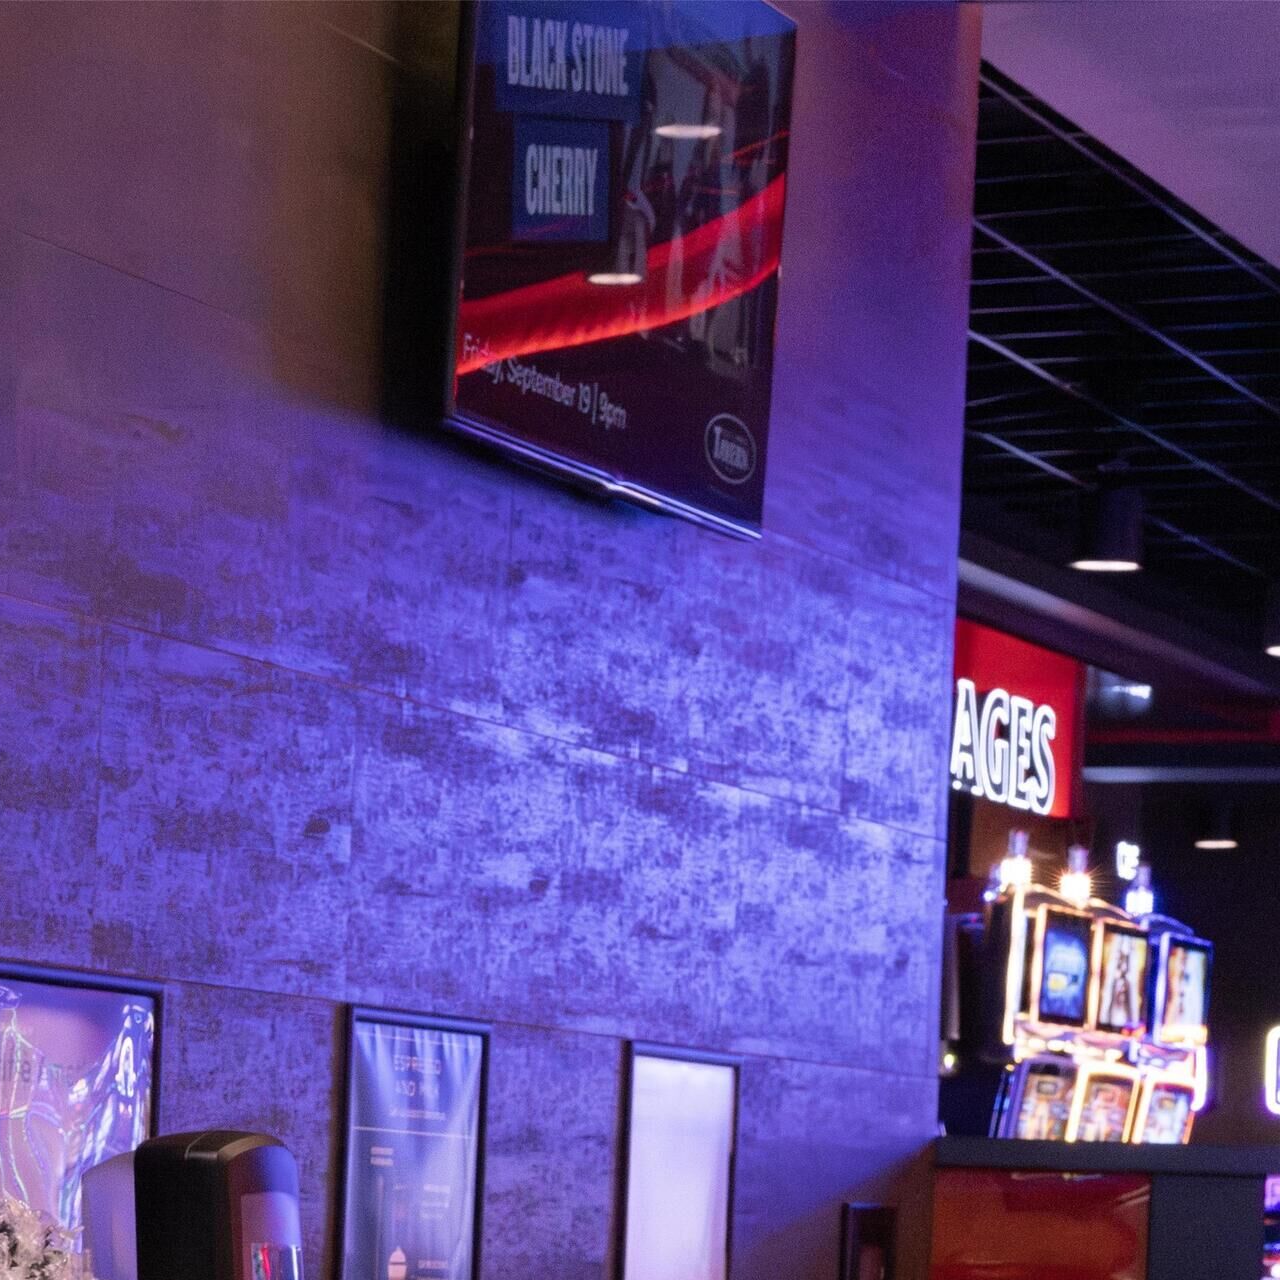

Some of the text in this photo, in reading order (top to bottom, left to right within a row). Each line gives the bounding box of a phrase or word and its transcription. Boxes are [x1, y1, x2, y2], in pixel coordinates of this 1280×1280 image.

[507, 15, 630, 96] BLACK STONE
[525, 143, 599, 216] CHERRY
